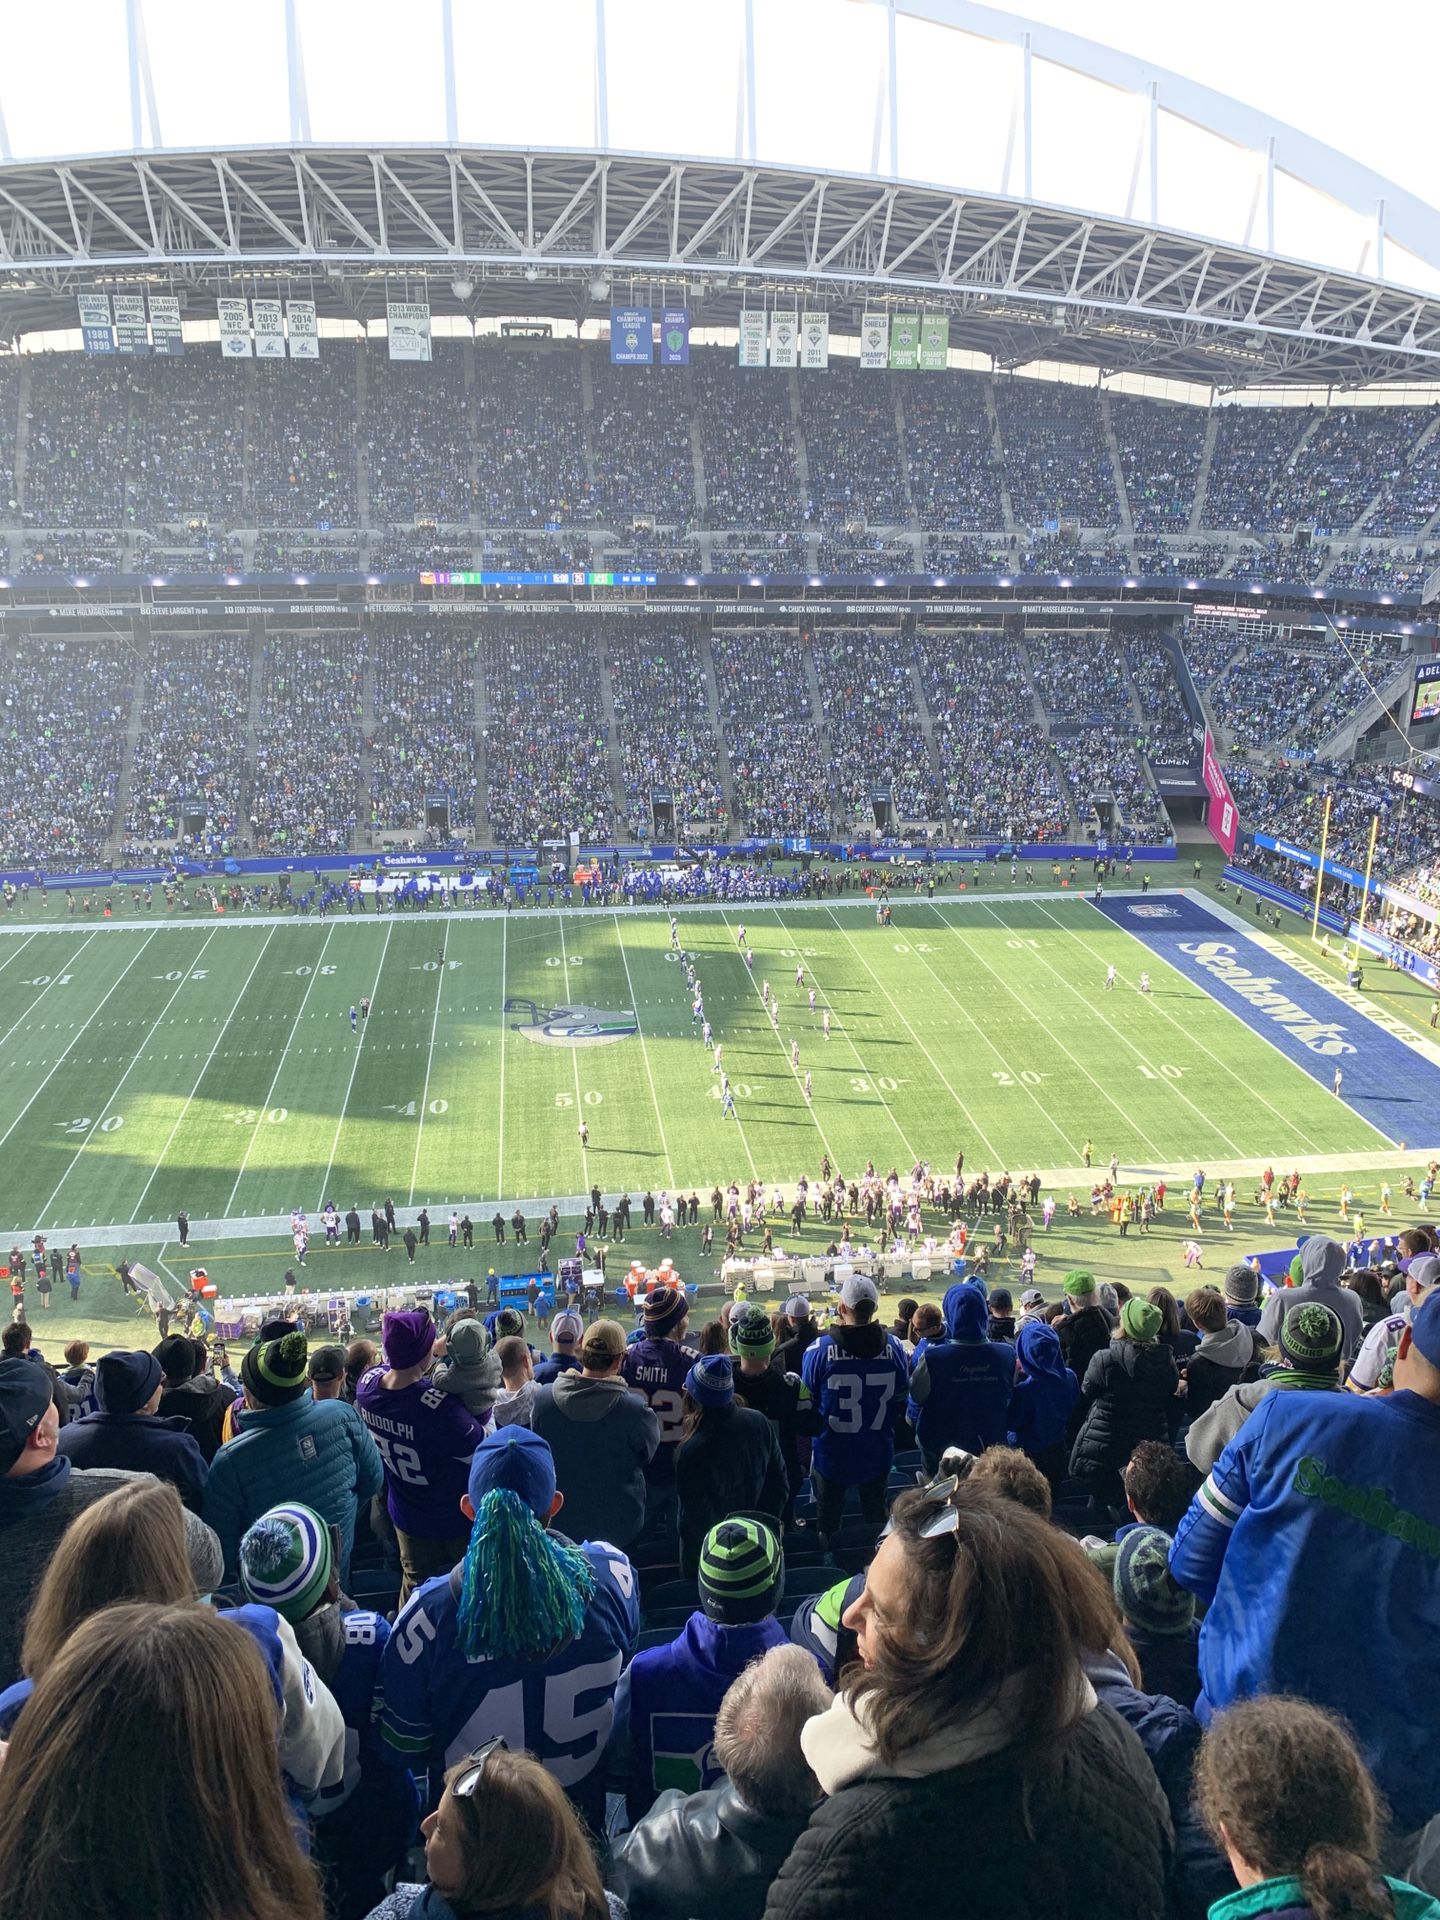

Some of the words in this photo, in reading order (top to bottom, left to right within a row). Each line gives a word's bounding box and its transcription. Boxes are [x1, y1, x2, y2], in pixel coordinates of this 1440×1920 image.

[80, 303, 109, 311] CHAMPS
[115, 303, 144, 312] CHAMPS
[150, 304, 180, 312] CHAMPS
[223, 312, 243, 321] 2005
[258, 313, 278, 322] 2013
[291, 315, 311, 324] 2014
[87, 330, 108, 340] 1988
[151, 607, 169, 615] STEVE
[169, 607, 195, 615] LARGENT
[300, 605, 314, 613] DAVE
[315, 605, 335, 613] BROWN
[856, 605, 875, 613] CORTEZ
[875, 605, 899, 613] KENNEDY
[934, 605, 953, 613] WALTER
[1393, 770, 1414, 788] 15:00
[791, 838, 807, 851] 12
[174, 855, 184, 864] 12
[384, 855, 428, 865] Seahawks
[1175, 942, 1358, 1055] Seahawks
[1284, 956, 1337, 985] TAKES
[1364, 1010, 1396, 1025] OF
[1390, 1027, 1423, 1043] US
[990, 1069, 1043, 1086] 20
[1136, 1063, 1184, 1079] 10
[705, 1082, 754, 1100] 40
[849, 1076, 901, 1092] 30
[554, 1090, 604, 1107] 50
[396, 1098, 450, 1117] 40
[234, 1106, 289, 1127] 30
[65, 1115, 125, 1135] 20
[635, 1365, 668, 1384] SMITH
[420, 1388, 449, 1410] 82
[827, 1370, 896, 1433] 37
[628, 1387, 685, 1443] 2
[360, 1407, 415, 1441] RUDOLPH
[344, 1610, 376, 1645] 80
[444, 1652, 623, 1788] 45
